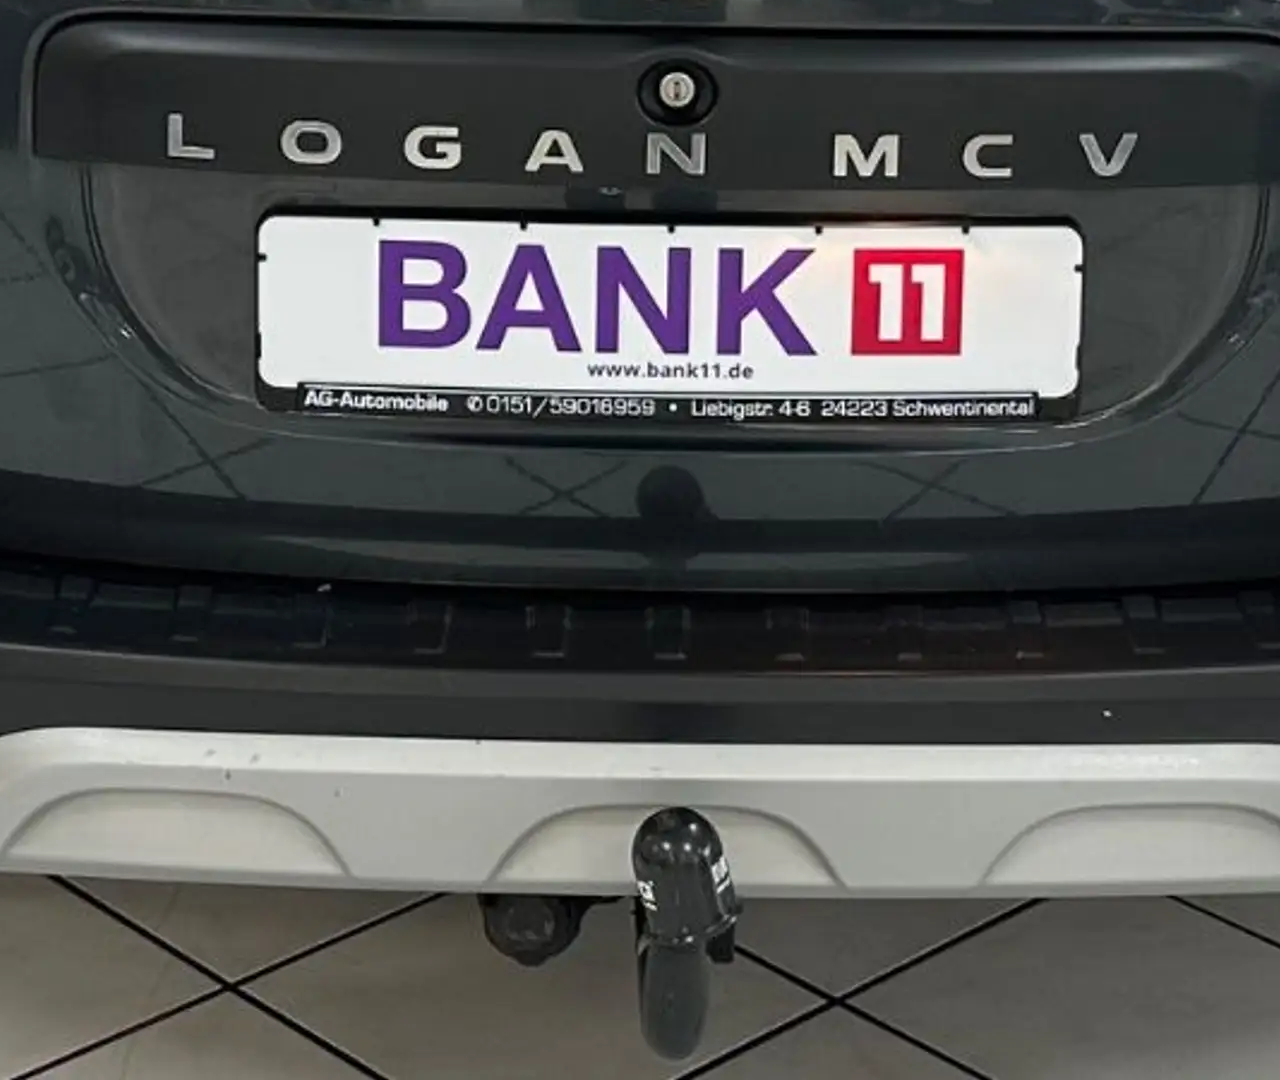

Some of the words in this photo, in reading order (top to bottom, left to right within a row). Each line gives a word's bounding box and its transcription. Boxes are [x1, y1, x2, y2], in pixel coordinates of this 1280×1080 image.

[167, 113, 706, 176] LOGAN
[832, 133, 1138, 178] MCV
[378, 239, 817, 357] BANK
[587, 360, 755, 381] www.bank11.de
[303, 390, 450, 413] AG-Automobile
[821, 400, 888, 418] 24223
[892, 397, 1036, 418] Schwentinental
